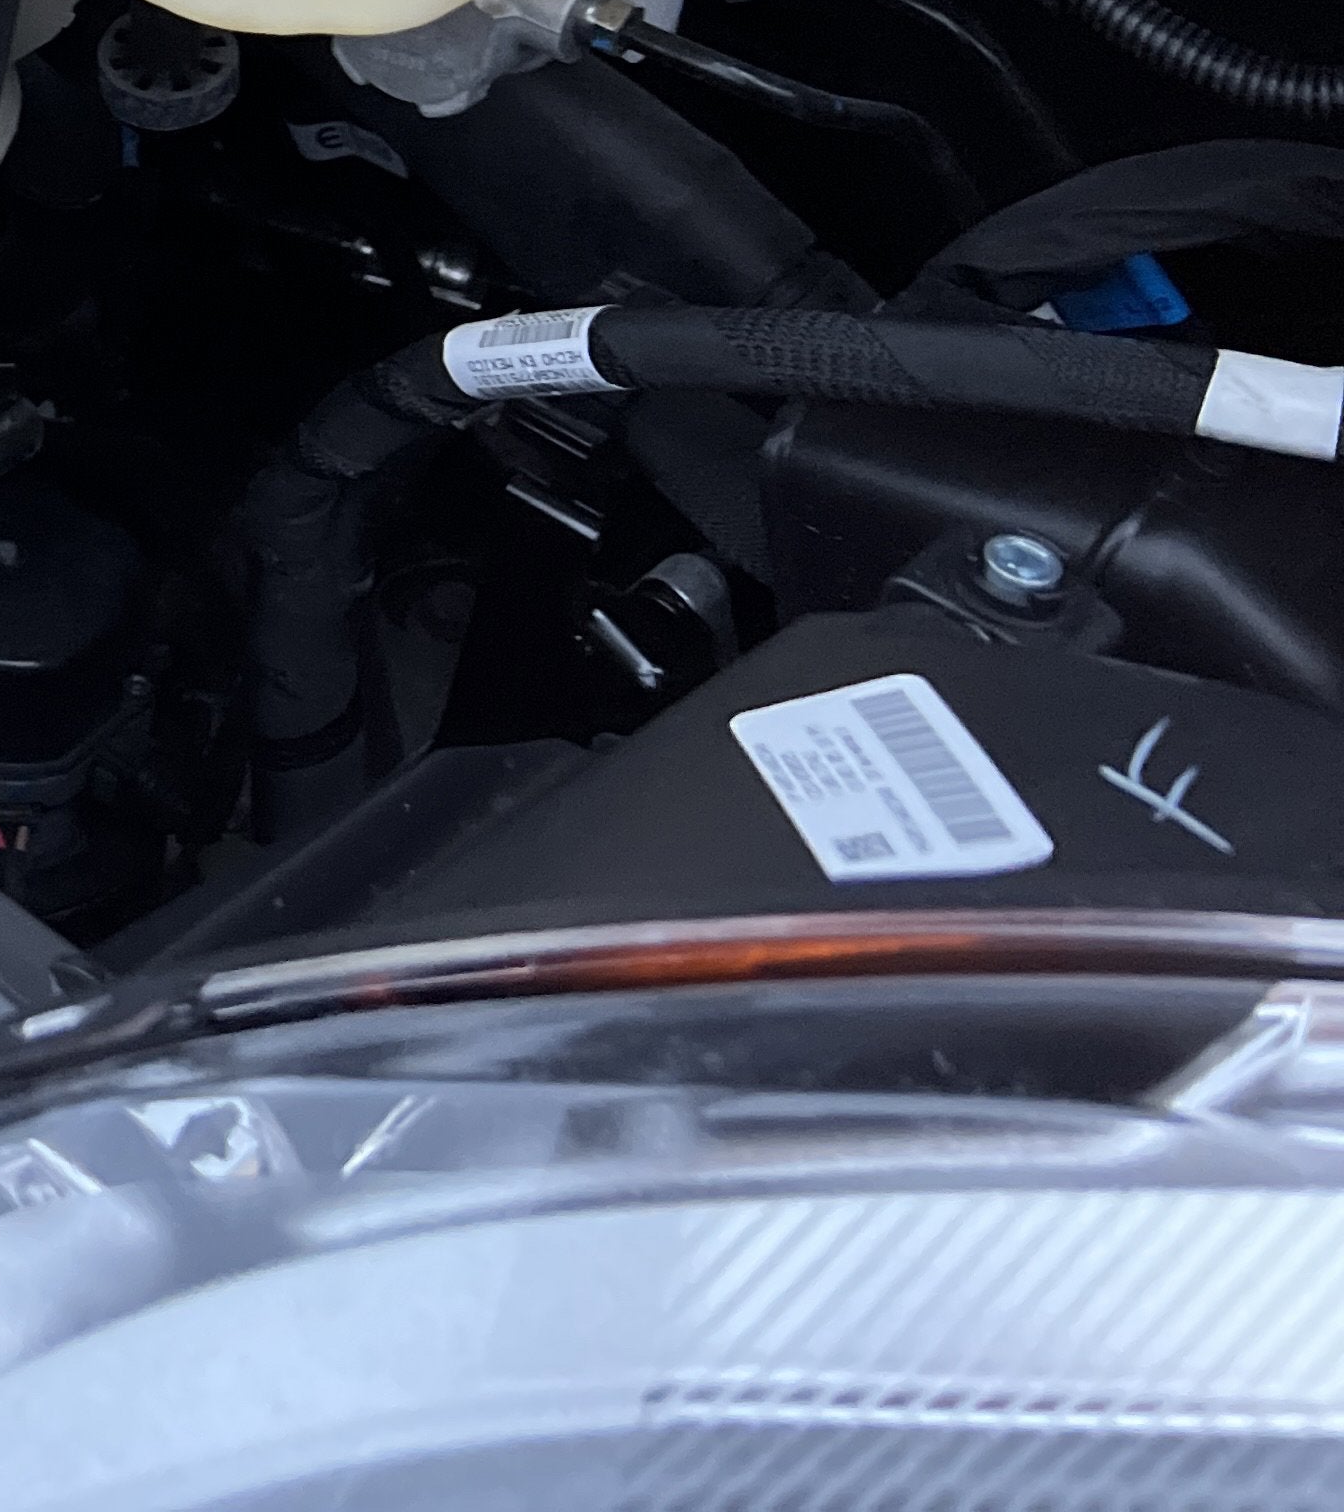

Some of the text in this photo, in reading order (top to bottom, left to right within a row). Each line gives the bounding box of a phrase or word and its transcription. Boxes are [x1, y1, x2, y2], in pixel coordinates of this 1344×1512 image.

[466, 350, 583, 372] HECHO EN MEXICO
